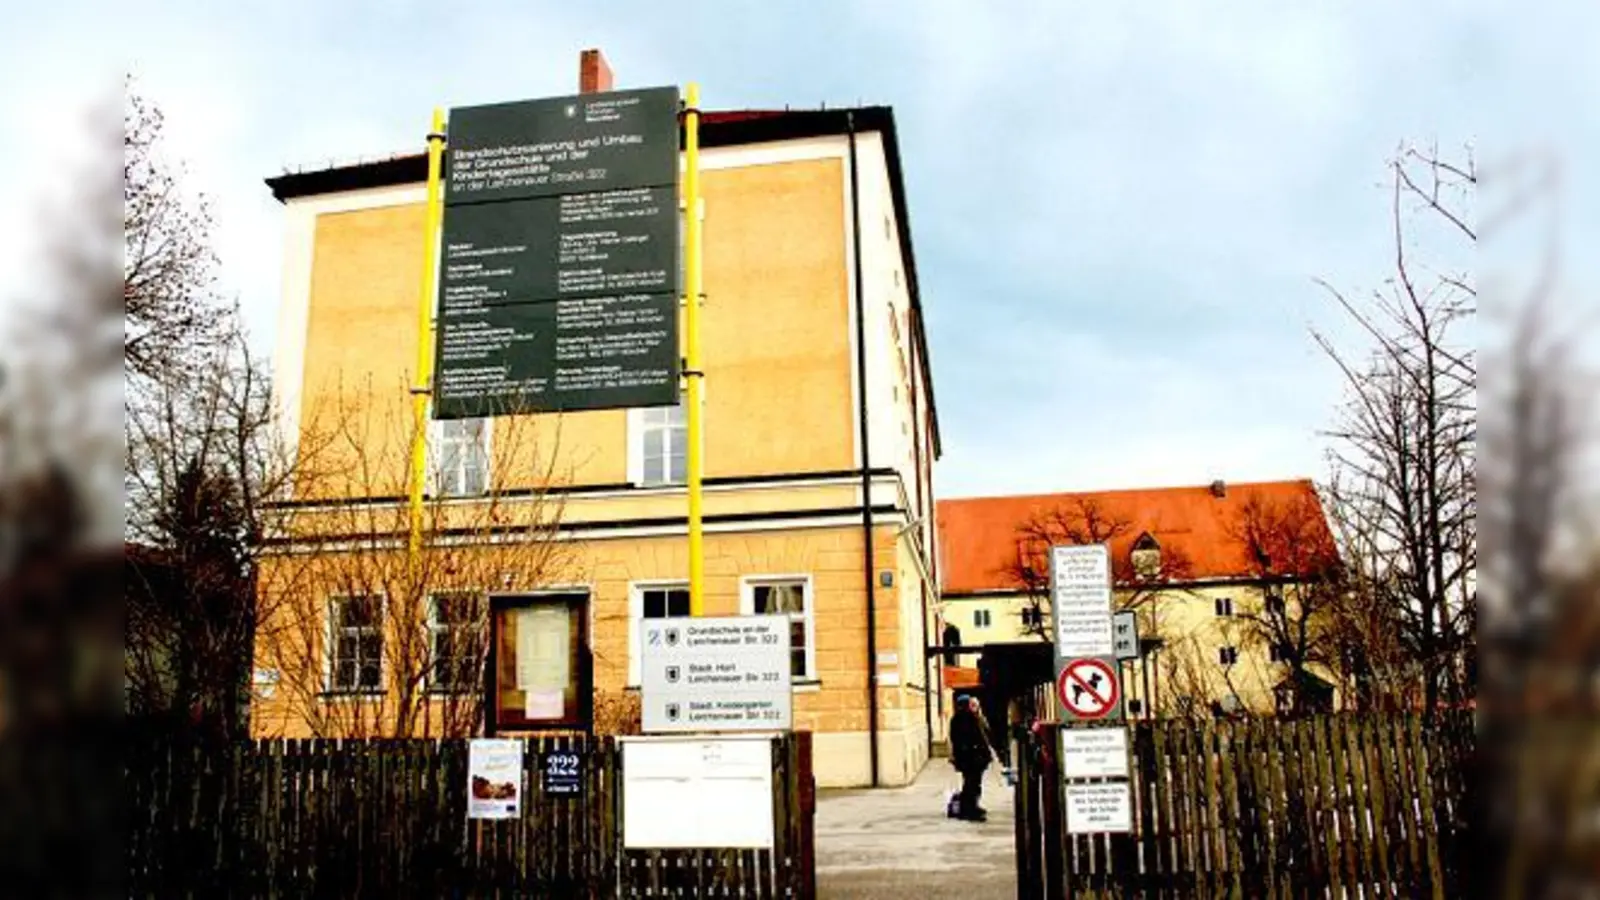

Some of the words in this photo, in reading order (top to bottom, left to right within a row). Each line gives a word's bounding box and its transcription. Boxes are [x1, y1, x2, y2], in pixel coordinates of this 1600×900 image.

[578, 137, 600, 149] und
[602, 134, 643, 145] Umbau
[453, 160, 472, 170] der
[474, 154, 543, 168] Grundschule
[545, 150, 568, 163] und
[570, 149, 589, 159] der
[468, 179, 484, 190] der
[687, 626, 741, 635] Grundschule
[755, 625, 770, 633] der
[761, 633, 779, 644] 322
[762, 671, 780, 681] 322
[546, 754, 579, 776] 322
